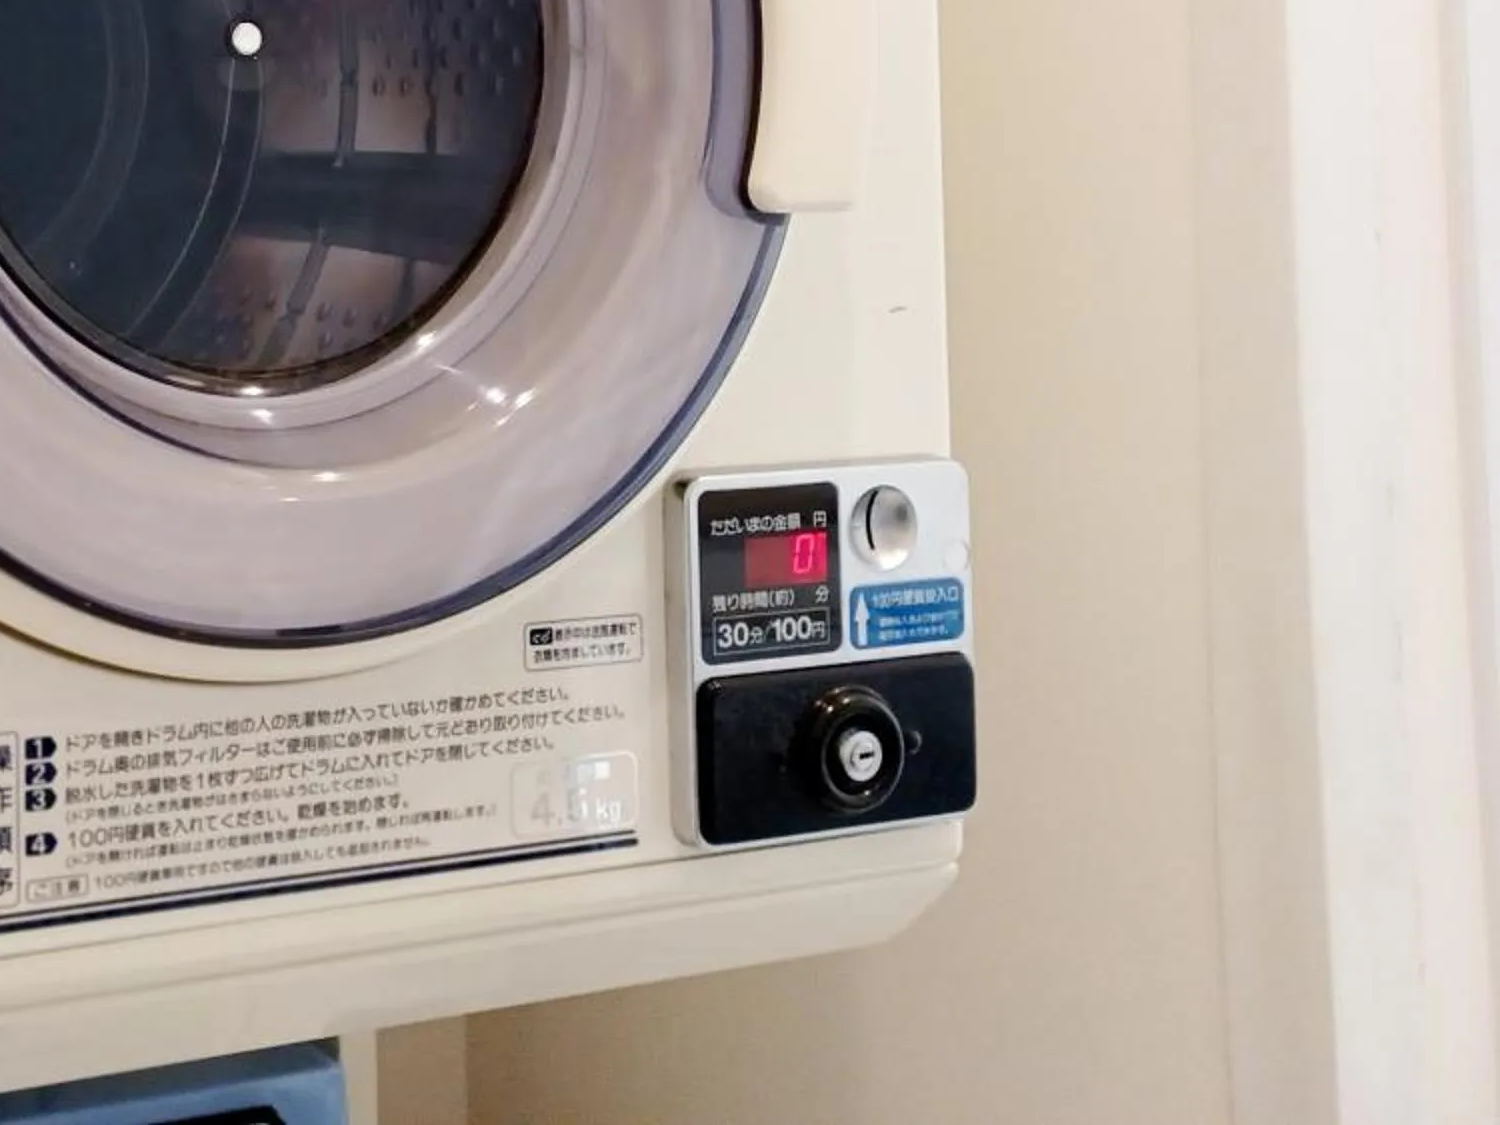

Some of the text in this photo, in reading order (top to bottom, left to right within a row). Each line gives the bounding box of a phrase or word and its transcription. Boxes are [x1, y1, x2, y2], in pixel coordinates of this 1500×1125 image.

[813, 510, 828, 529] 円
[792, 532, 815, 575] 0
[814, 584, 830, 604] 分
